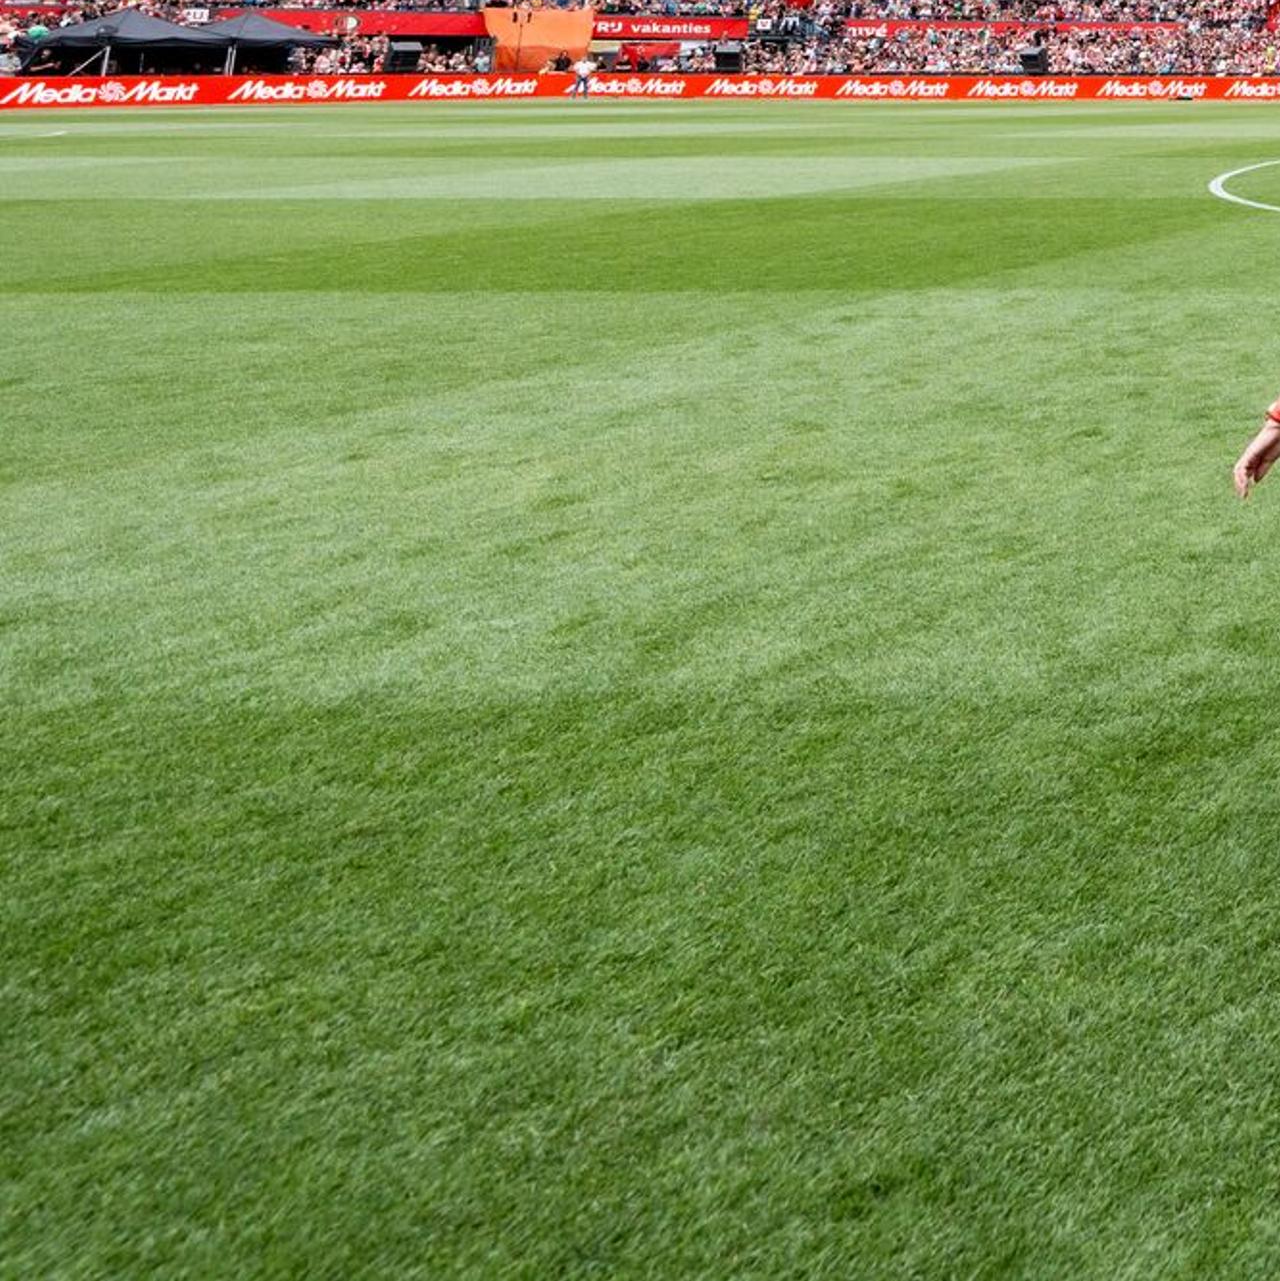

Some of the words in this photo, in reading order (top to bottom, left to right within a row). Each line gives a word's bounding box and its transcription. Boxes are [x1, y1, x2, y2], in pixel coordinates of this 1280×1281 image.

[631, 21, 712, 34] vakanties
[0, 81, 97, 104] Media
[118, 80, 199, 101] Markt
[228, 80, 305, 100] Media
[324, 79, 386, 98] Markt
[408, 78, 470, 96] Media
[487, 77, 537, 95] Markt
[640, 78, 686, 93] Markt
[704, 78, 758, 95] Media
[771, 78, 818, 95] Markt
[835, 79, 889, 96] Media
[904, 80, 950, 96] Markt
[967, 79, 1021, 96] Media
[1032, 80, 1078, 96] Markt
[1096, 80, 1147, 96] Media
[1161, 80, 1207, 96] Markt
[1224, 80, 1275, 96] Media
